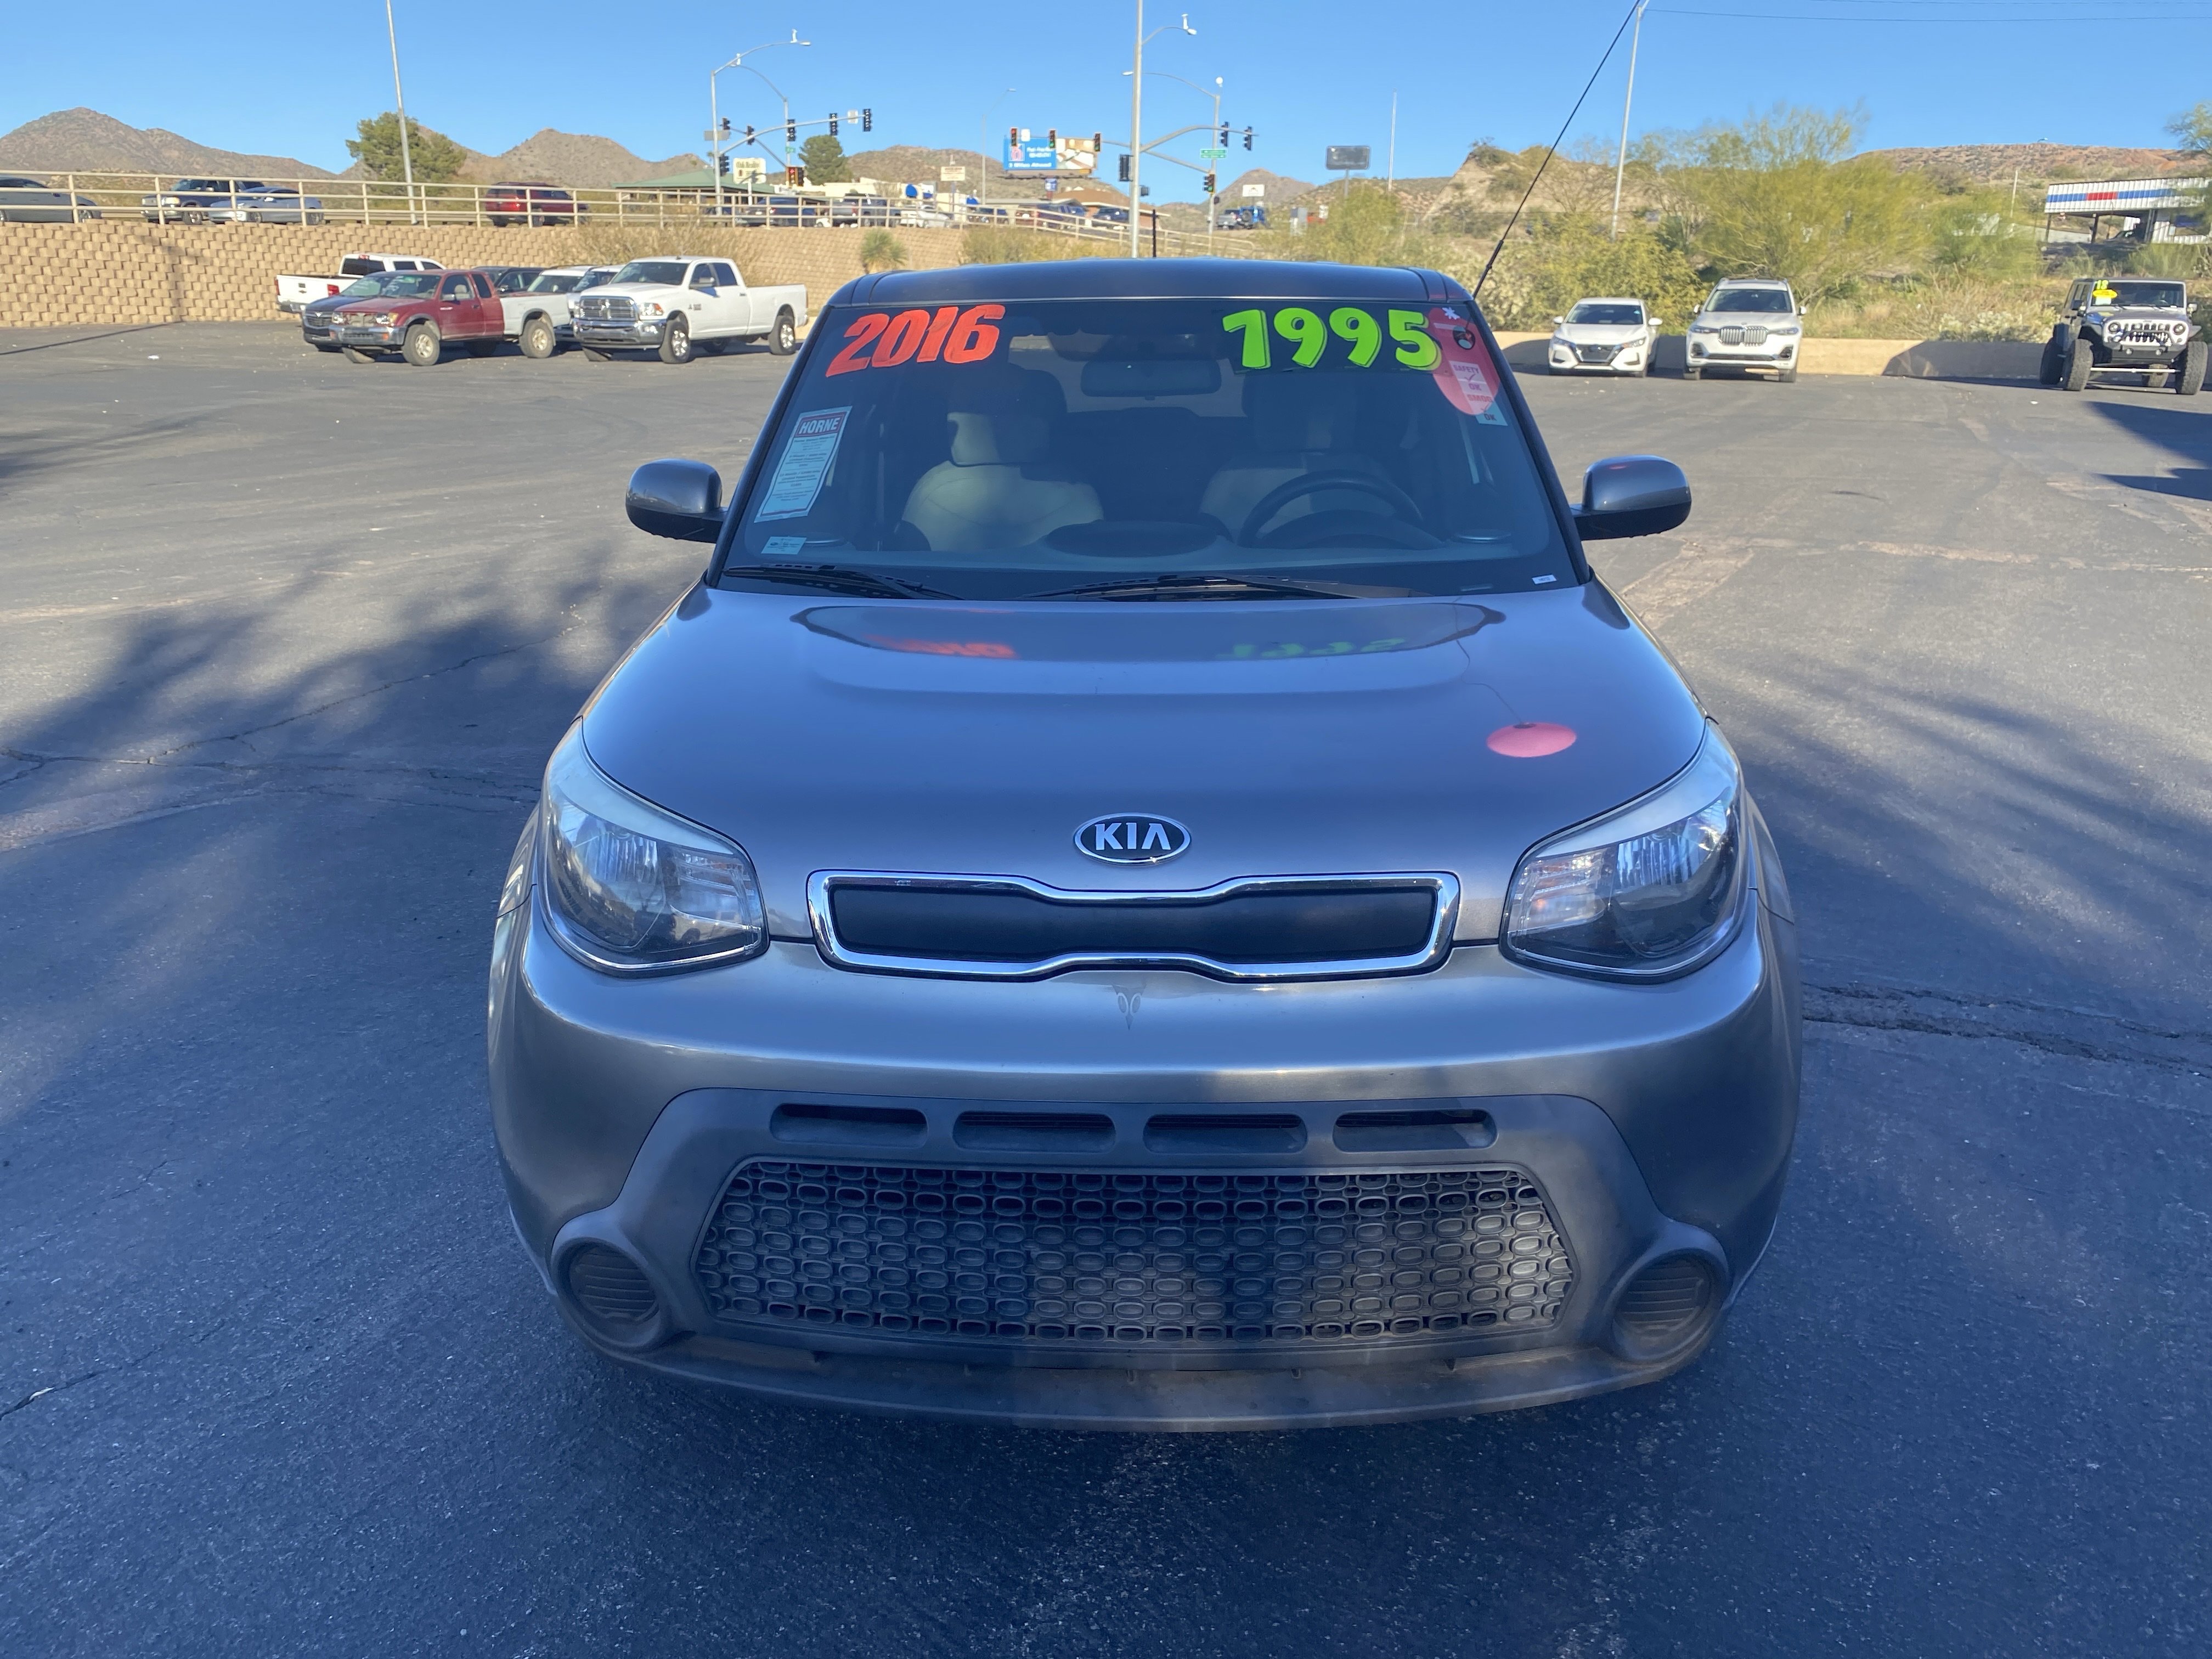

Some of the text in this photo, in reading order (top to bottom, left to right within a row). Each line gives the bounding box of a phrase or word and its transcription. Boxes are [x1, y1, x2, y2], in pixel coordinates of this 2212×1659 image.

[825, 304, 1006, 377] 2016
[1222, 307, 1442, 371] 7995
[1452, 364, 1479, 374] SAFETY
[1468, 383, 1482, 391] OK
[798, 417, 841, 435] HORNE
[1483, 413, 1497, 421] OK
[1094, 822, 1171, 850] KIA
